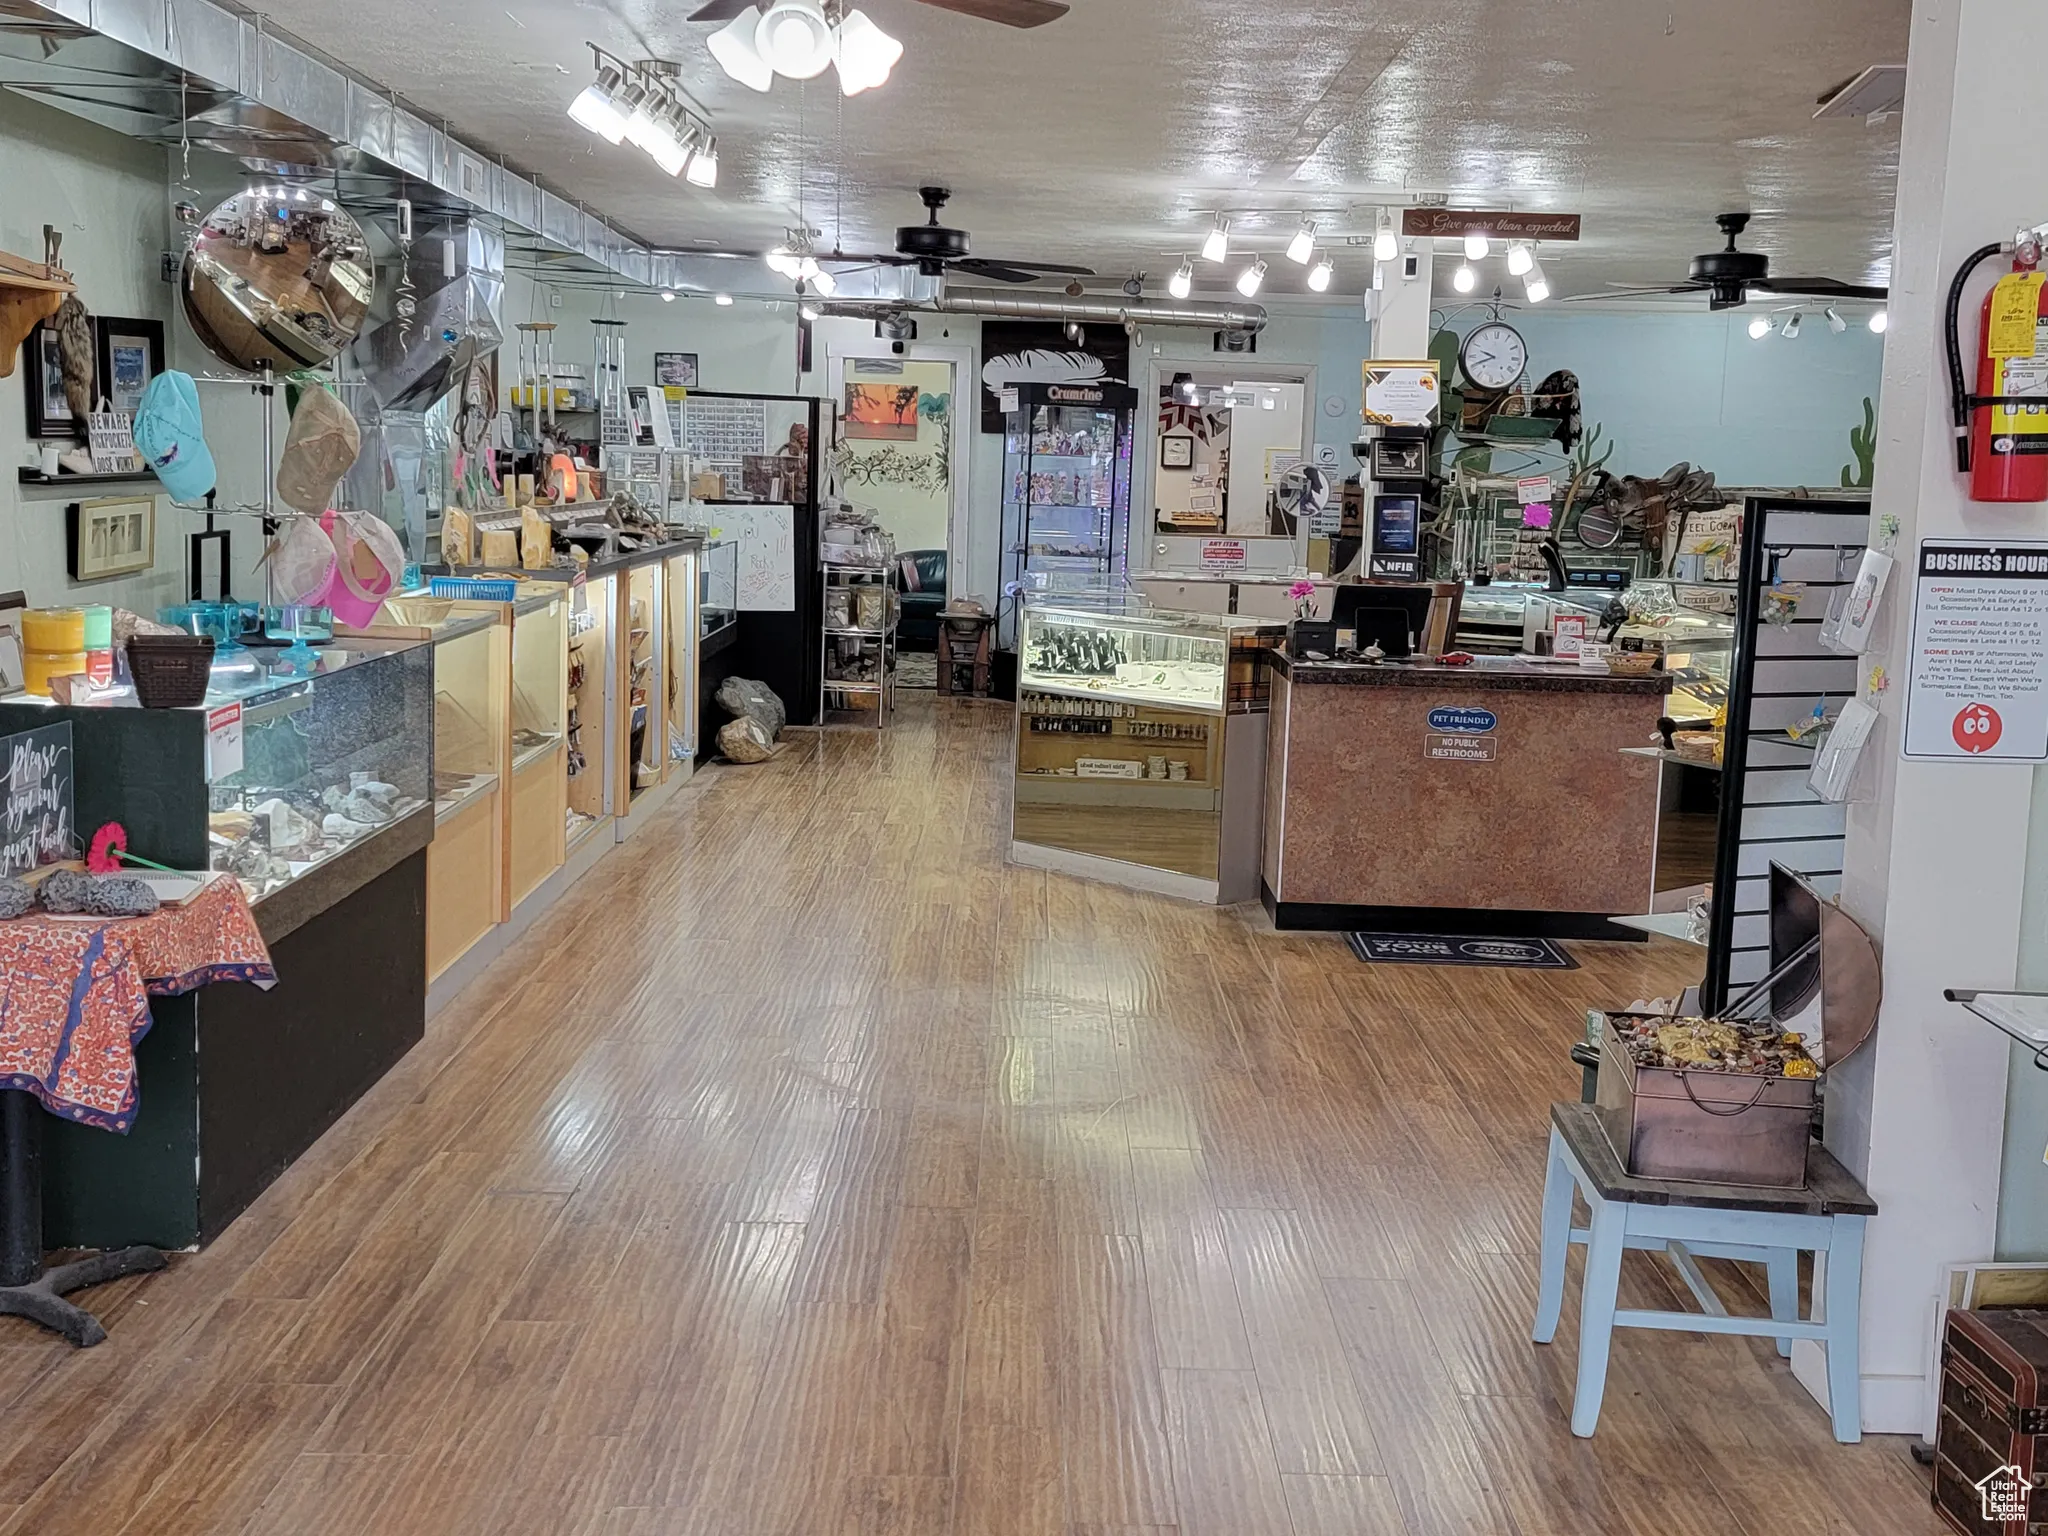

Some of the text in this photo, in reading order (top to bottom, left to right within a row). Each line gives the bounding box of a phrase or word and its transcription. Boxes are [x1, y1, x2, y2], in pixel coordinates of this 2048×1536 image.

[1431, 213, 1574, 235] Give more than expected.
[1047, 385, 1104, 401] Crumrine
[90, 414, 128, 430] BEWARE
[90, 433, 132, 448] PICKPOCKETS
[94, 456, 134, 473] LOOSE WOMEN
[1386, 562, 1414, 572] NFIB
[1925, 554, 2002, 572] BUSINESS
[1939, 596, 1986, 604] Occasionally
[1998, 597, 2017, 605] Early
[1940, 604, 1979, 612] Somedays
[1929, 627, 1975, 635] Occasionally
[1926, 636, 1968, 644] Sometimes
[1969, 675, 1994, 683] Except
[1449, 716, 1491, 725] FRIENDLY
[1442, 738, 1480, 748] NO PUBLIC
[1432, 748, 1488, 759] RESTROOMS
[0, 737, 68, 792] please
[2, 773, 68, 834] sign our
[0, 806, 68, 879] guest book
[1374, 942, 1449, 950] YOUR
[1375, 947, 1455, 955] PLACE
